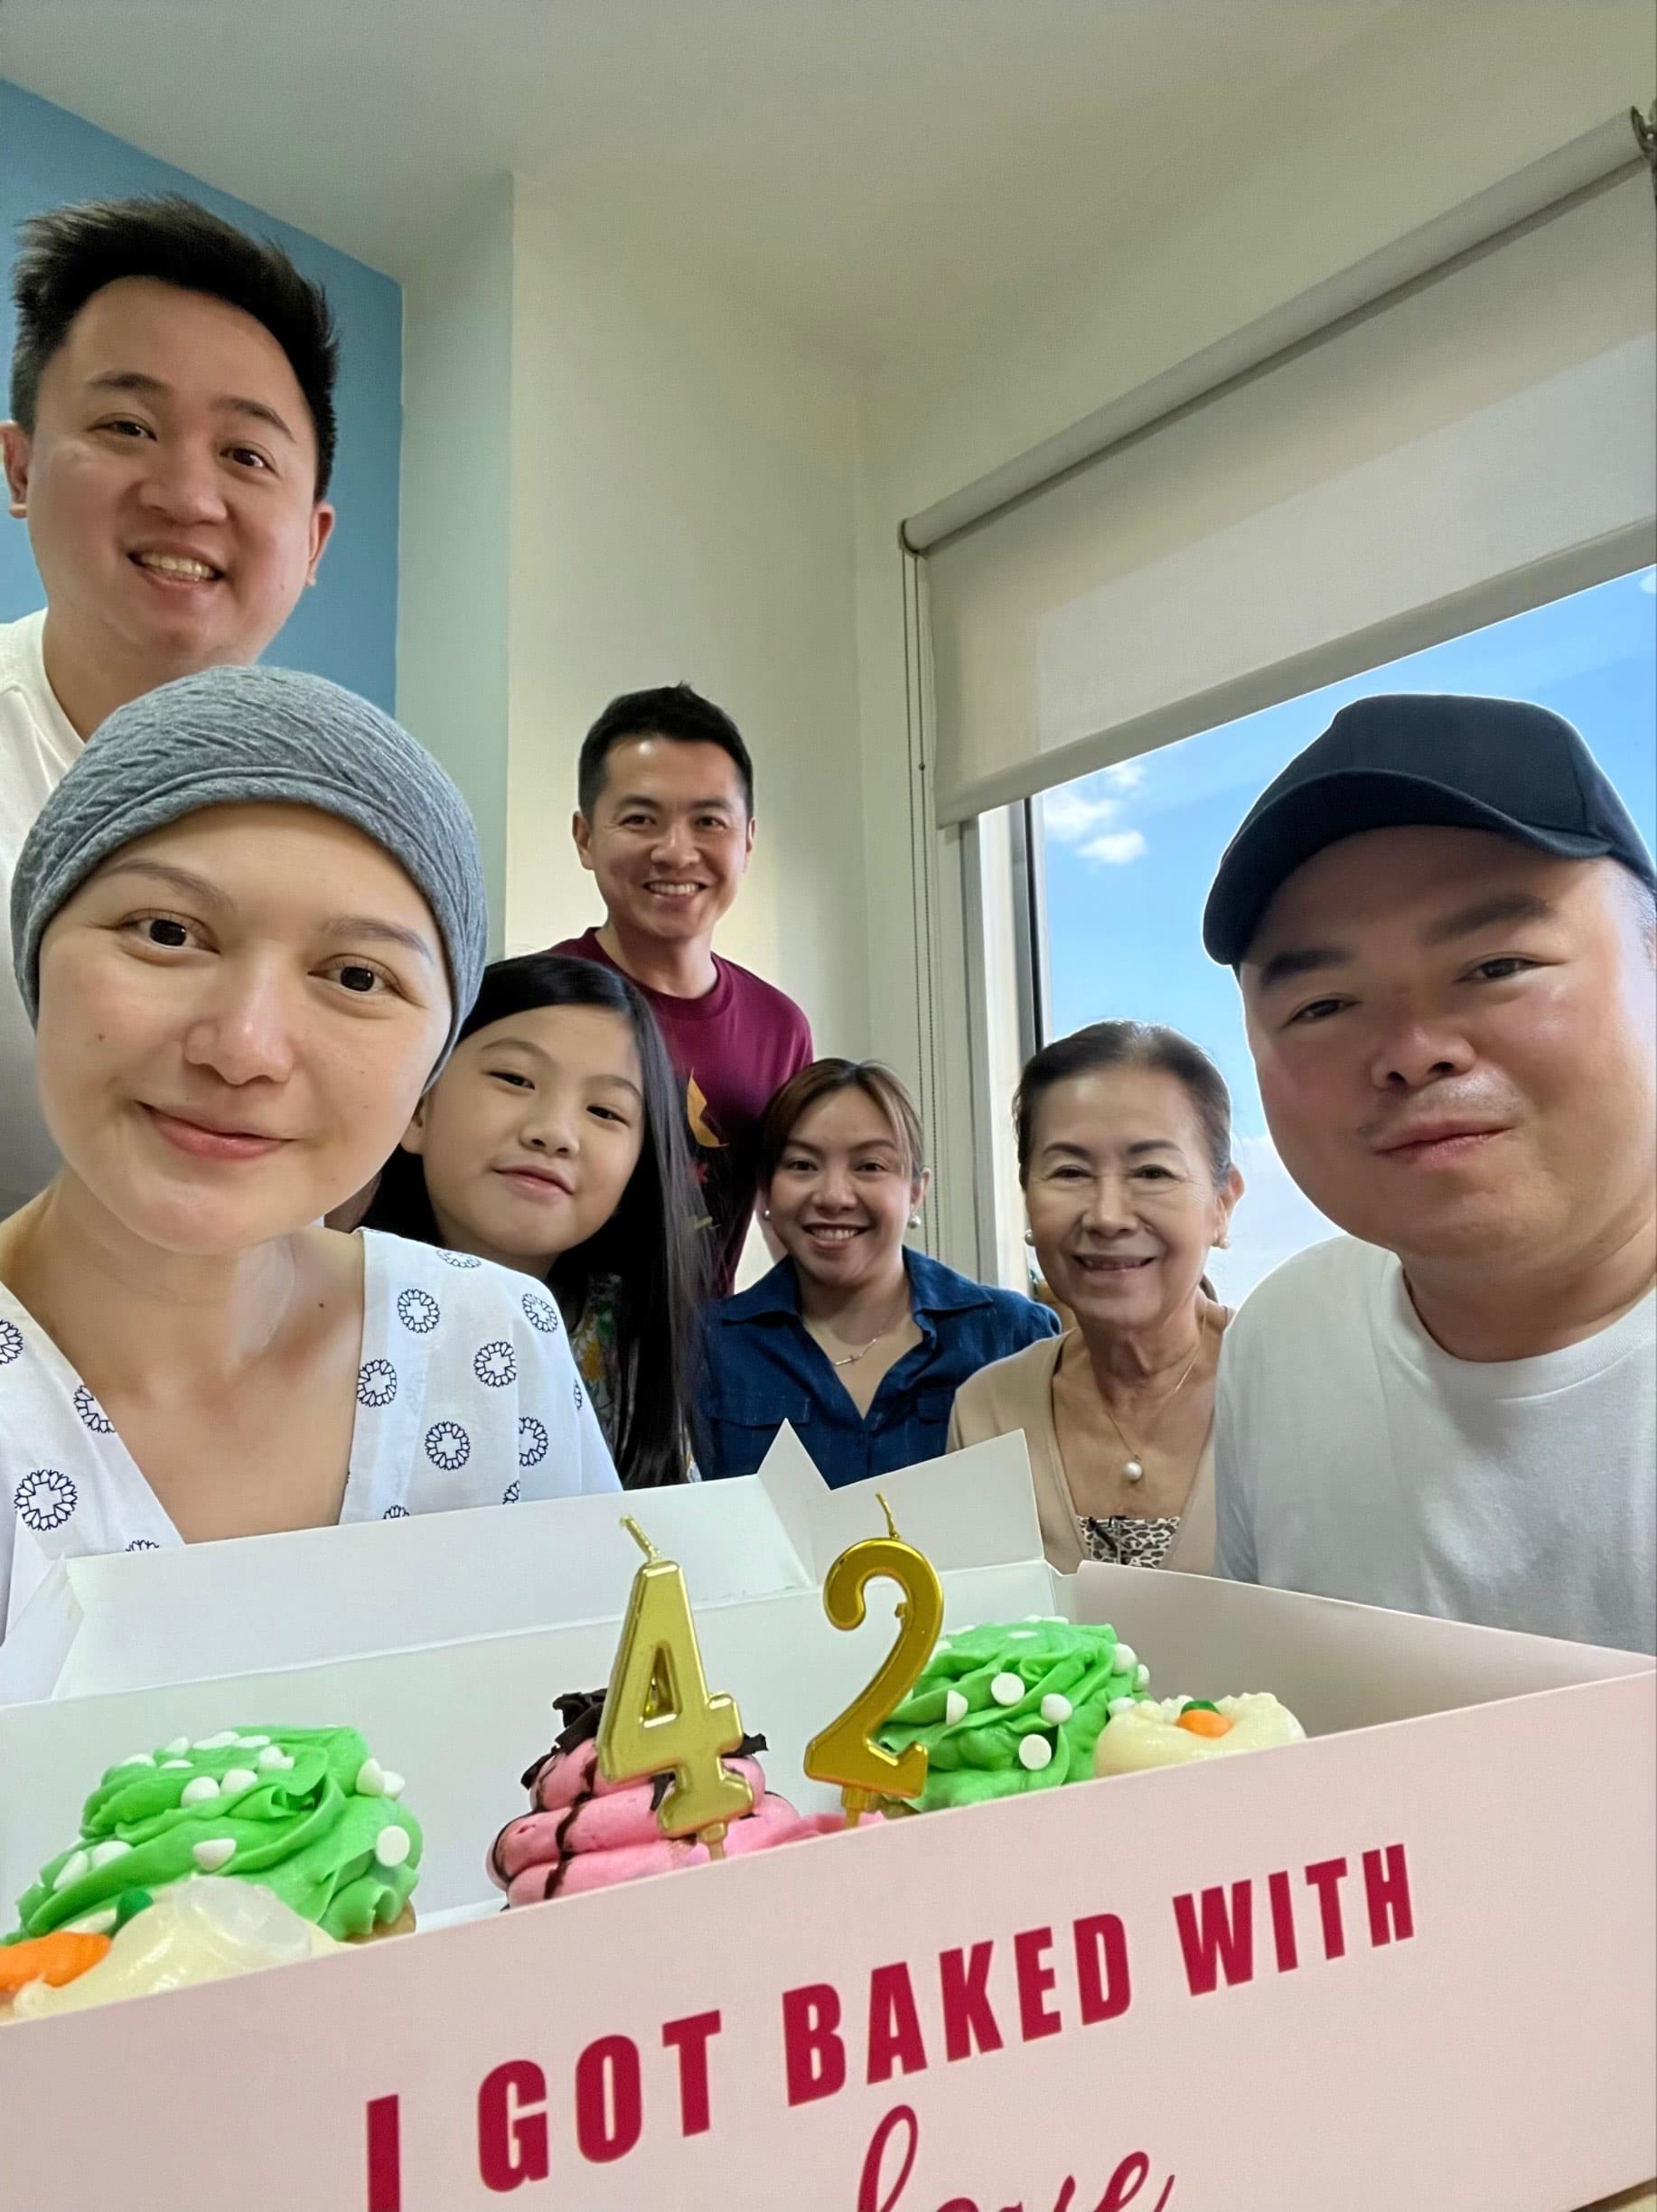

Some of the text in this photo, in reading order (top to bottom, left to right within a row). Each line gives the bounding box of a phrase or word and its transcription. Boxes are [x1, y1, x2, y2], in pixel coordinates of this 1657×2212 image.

[596, 1537, 944, 1837] 42
[367, 1843, 1415, 2212] I GOT BAKED WITH
